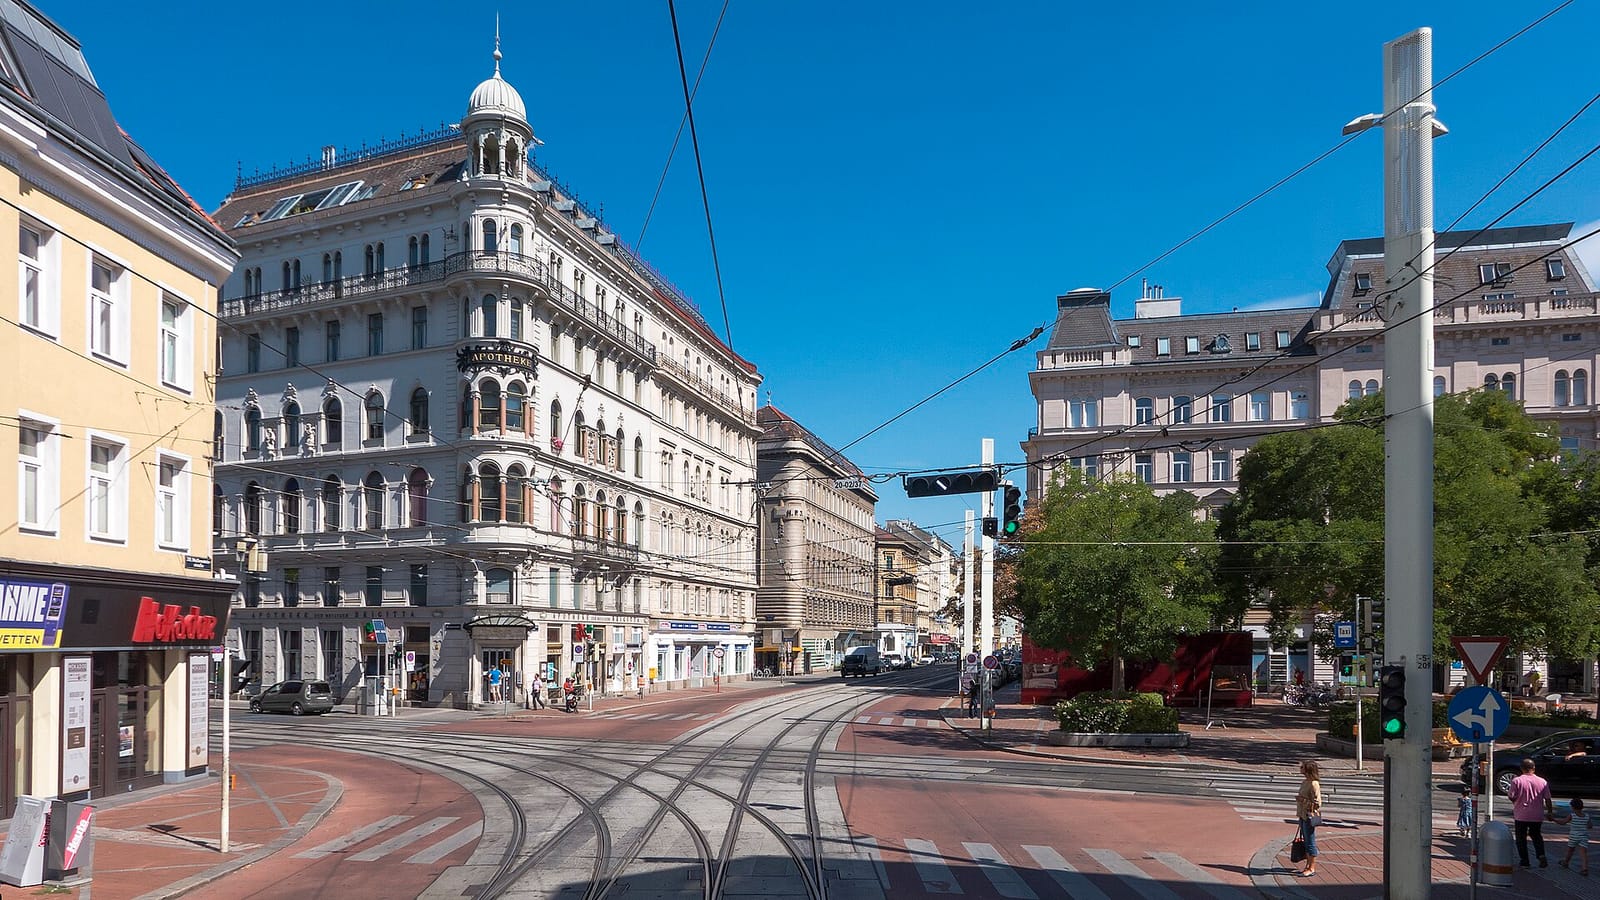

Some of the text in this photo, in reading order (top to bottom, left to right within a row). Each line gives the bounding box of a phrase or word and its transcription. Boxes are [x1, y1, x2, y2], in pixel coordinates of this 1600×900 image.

[471, 352, 532, 368] APOTHEKE
[834, 480, 862, 489] 20-02/37
[0, 584, 49, 622] HME
